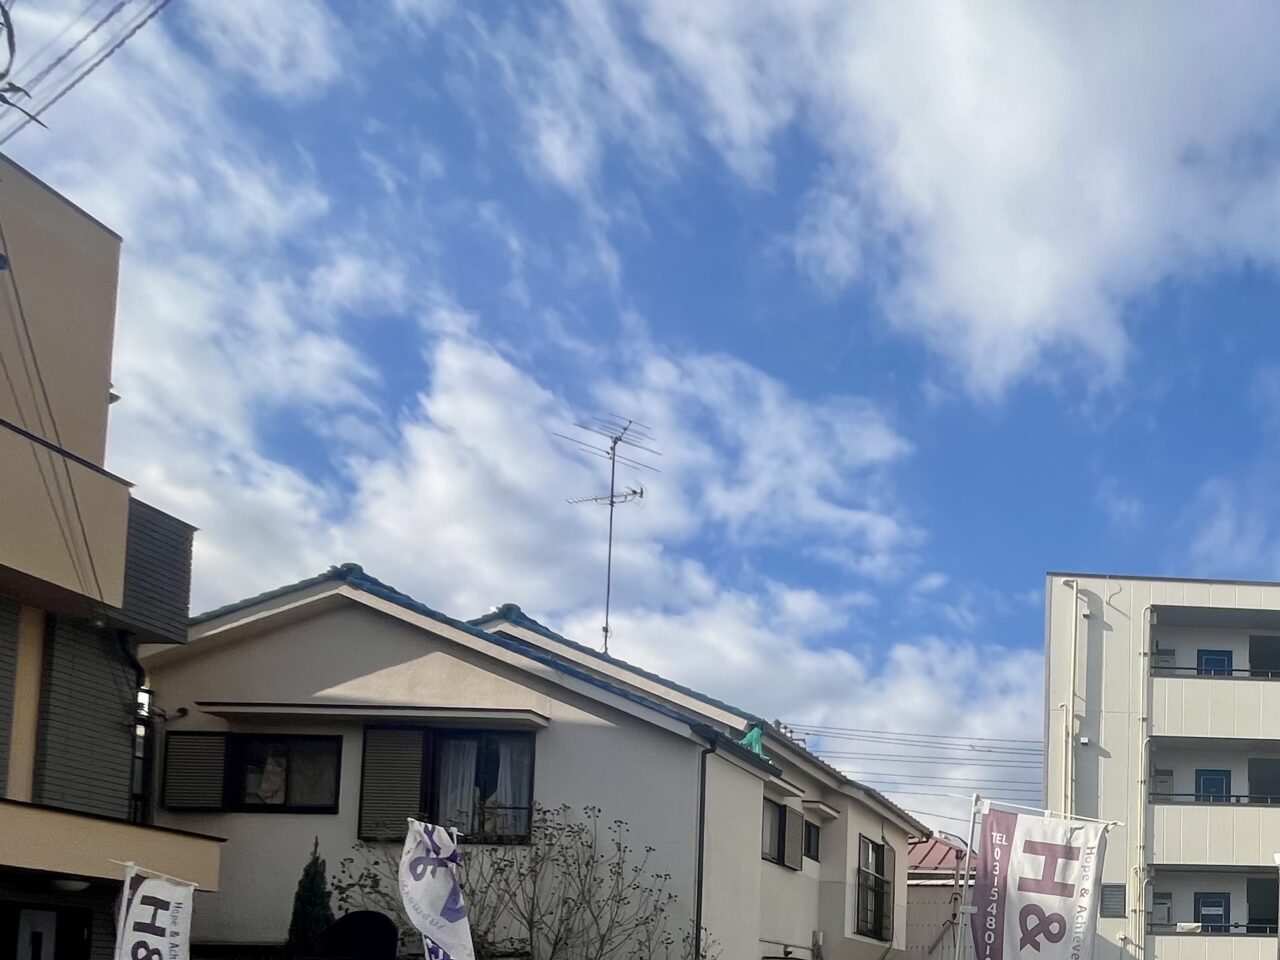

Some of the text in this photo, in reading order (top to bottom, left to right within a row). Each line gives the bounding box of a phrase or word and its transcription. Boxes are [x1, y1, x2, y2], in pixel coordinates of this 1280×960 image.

[991, 832, 1008, 846] TEL
[1080, 846, 1095, 884] Hope
[1079, 888, 1090, 898] &
